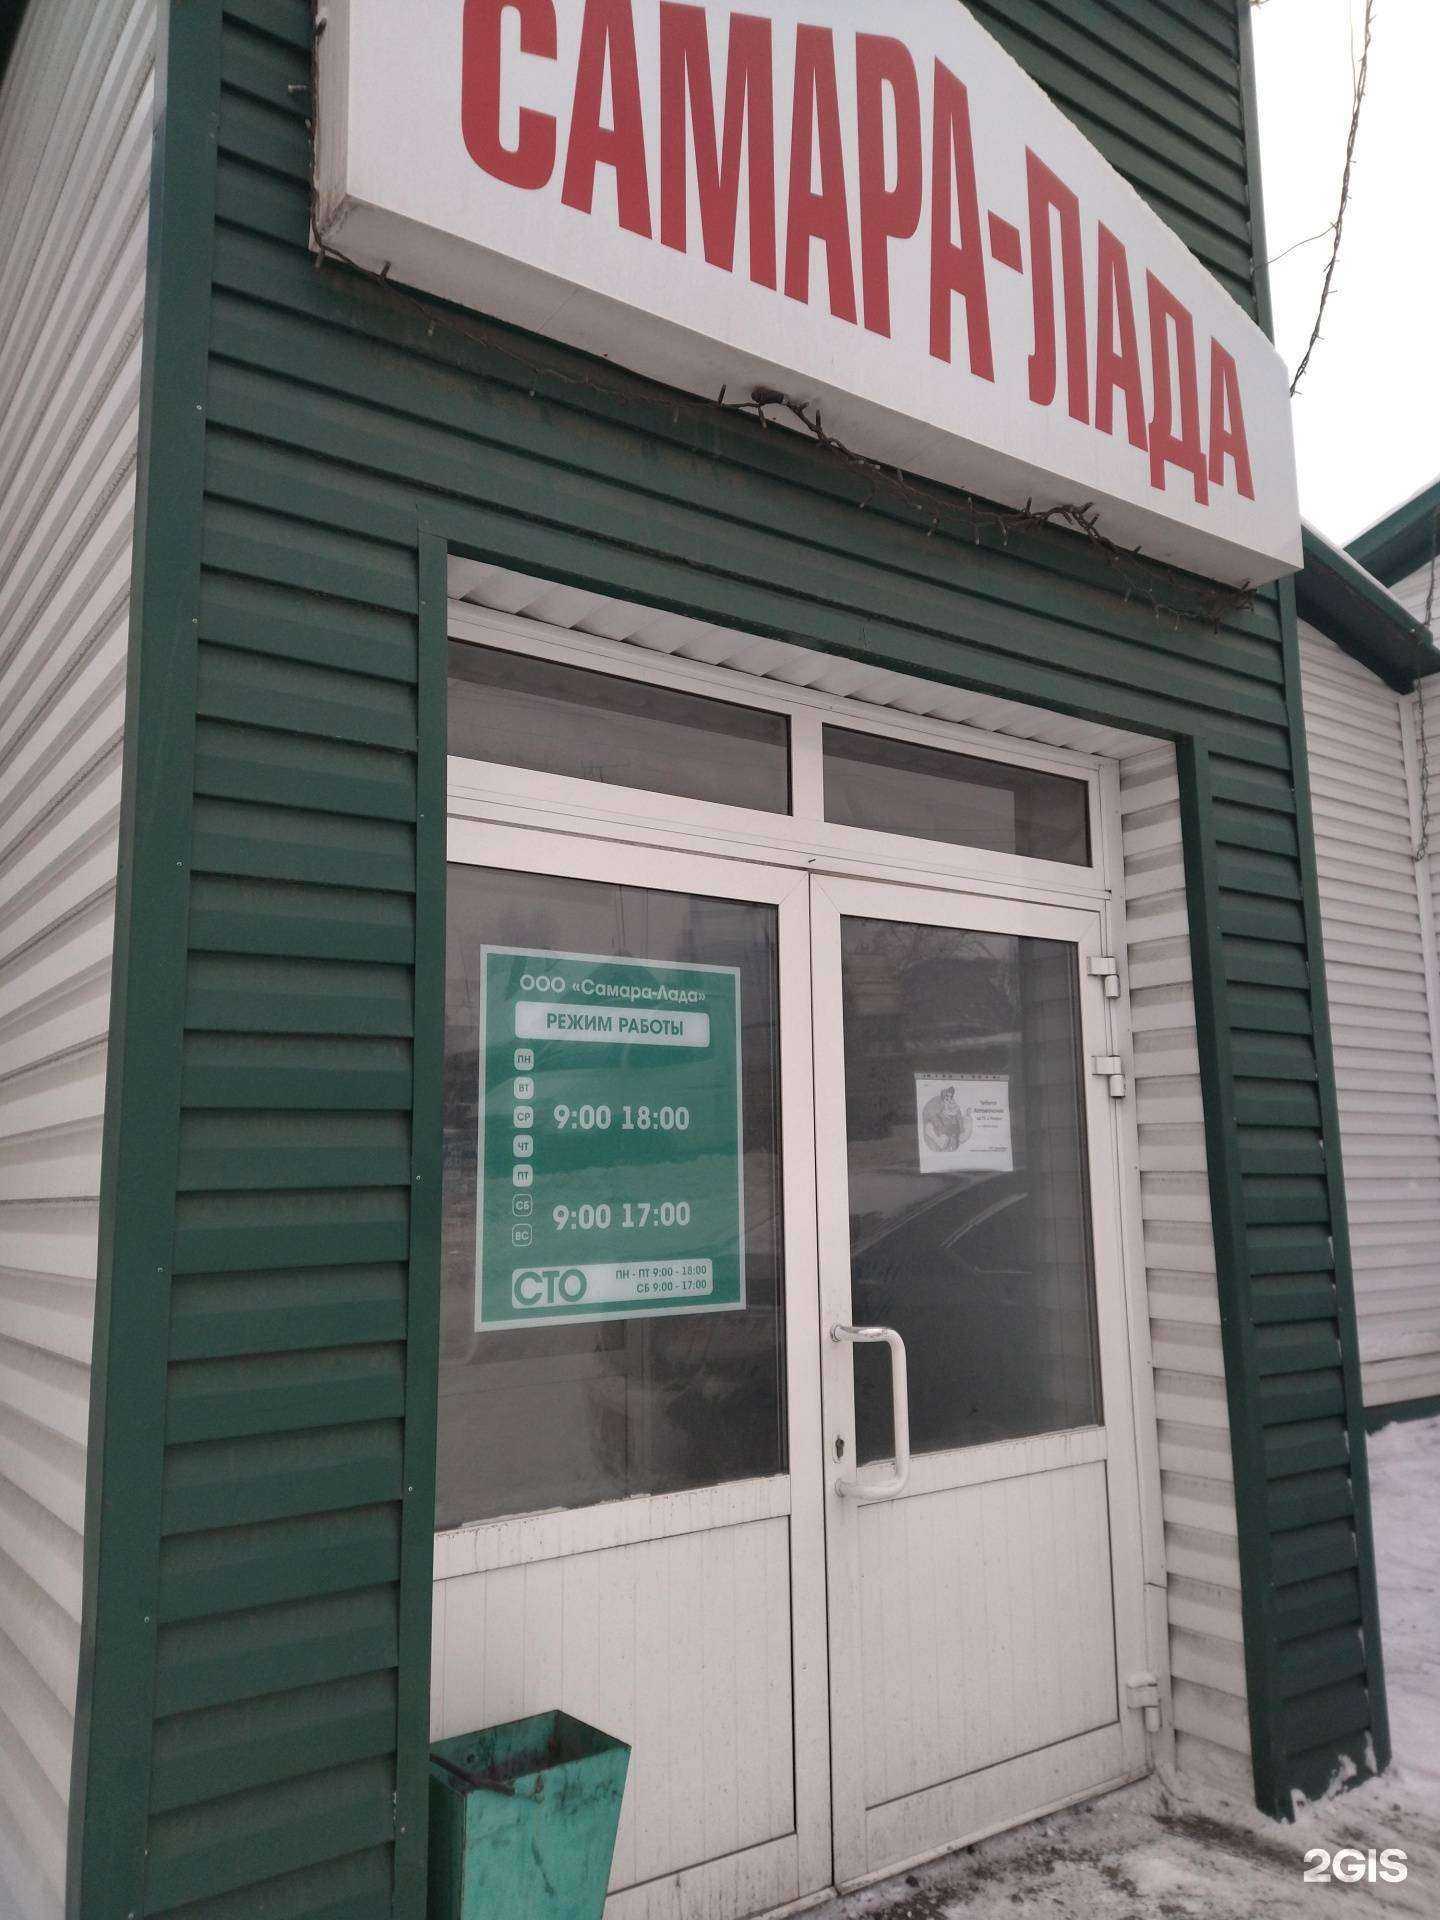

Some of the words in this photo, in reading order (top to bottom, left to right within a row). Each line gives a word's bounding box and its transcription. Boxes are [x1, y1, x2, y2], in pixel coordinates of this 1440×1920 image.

[461, 0, 1254, 505] САМАРА-ЛАДА
[520, 975, 565, 992] ООО
[572, 979, 705, 1003] «Самара-Лада»
[547, 1013, 612, 1032] РЕЖИМ
[619, 1017, 683, 1035] РАБОТЫ
[518, 1055, 531, 1064] ПН
[519, 1084, 529, 1092] ВТ
[517, 1113, 531, 1121] СР
[554, 1105, 611, 1129] 9:00
[623, 1106, 689, 1129] 18:00
[518, 1142, 529, 1151] ЧТ
[517, 1171, 529, 1180] ПТ
[553, 1205, 611, 1230] 9:00
[623, 1201, 690, 1227] 17:00
[515, 1231, 529, 1240] ВС
[616, 1270, 629, 1280] ПН
[639, 1269, 649, 1278] ПТ
[653, 1268, 672, 1278] 9:00
[682, 1265, 707, 1275] 18:00
[514, 1269, 587, 1305] СТО
[637, 1284, 649, 1293] СБ
[653, 1282, 672, 1292] 9:00
[682, 1280, 707, 1289] 17:00
